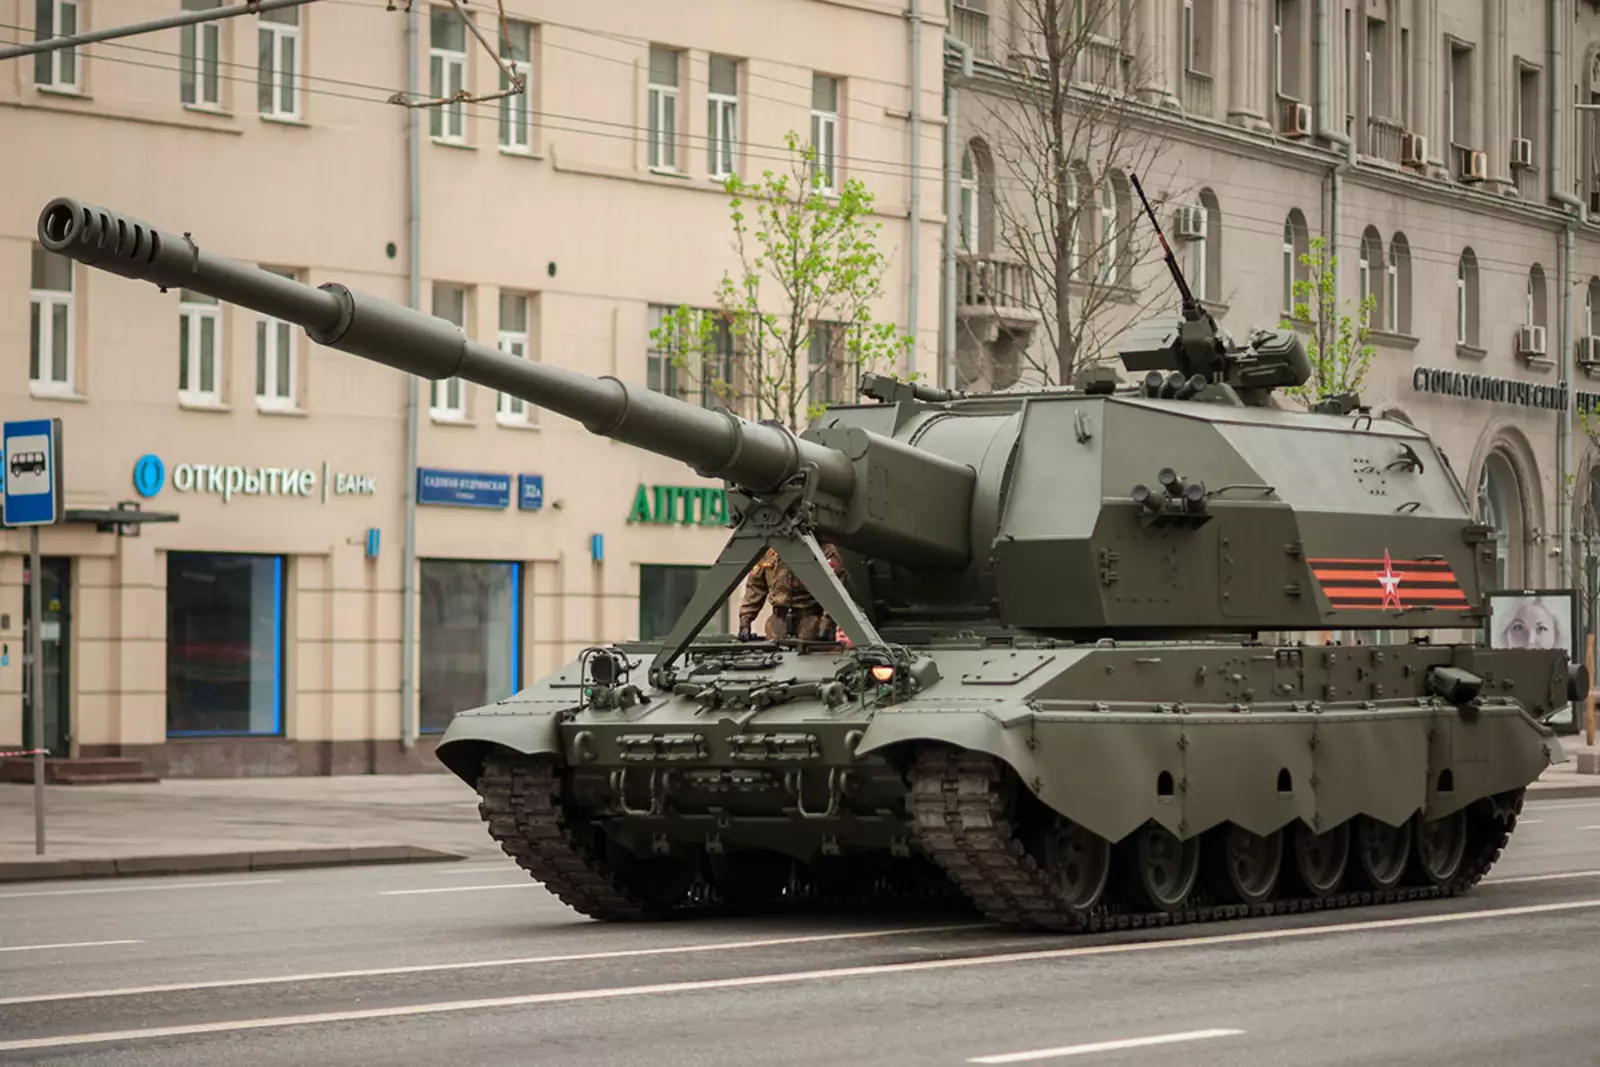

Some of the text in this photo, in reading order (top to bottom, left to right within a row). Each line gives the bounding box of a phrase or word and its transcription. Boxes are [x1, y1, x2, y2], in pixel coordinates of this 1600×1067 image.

[1413, 367, 1569, 411] СТОМАТОЛОГИЧЕСКИЙ
[173, 462, 376, 503] открытие БАНК
